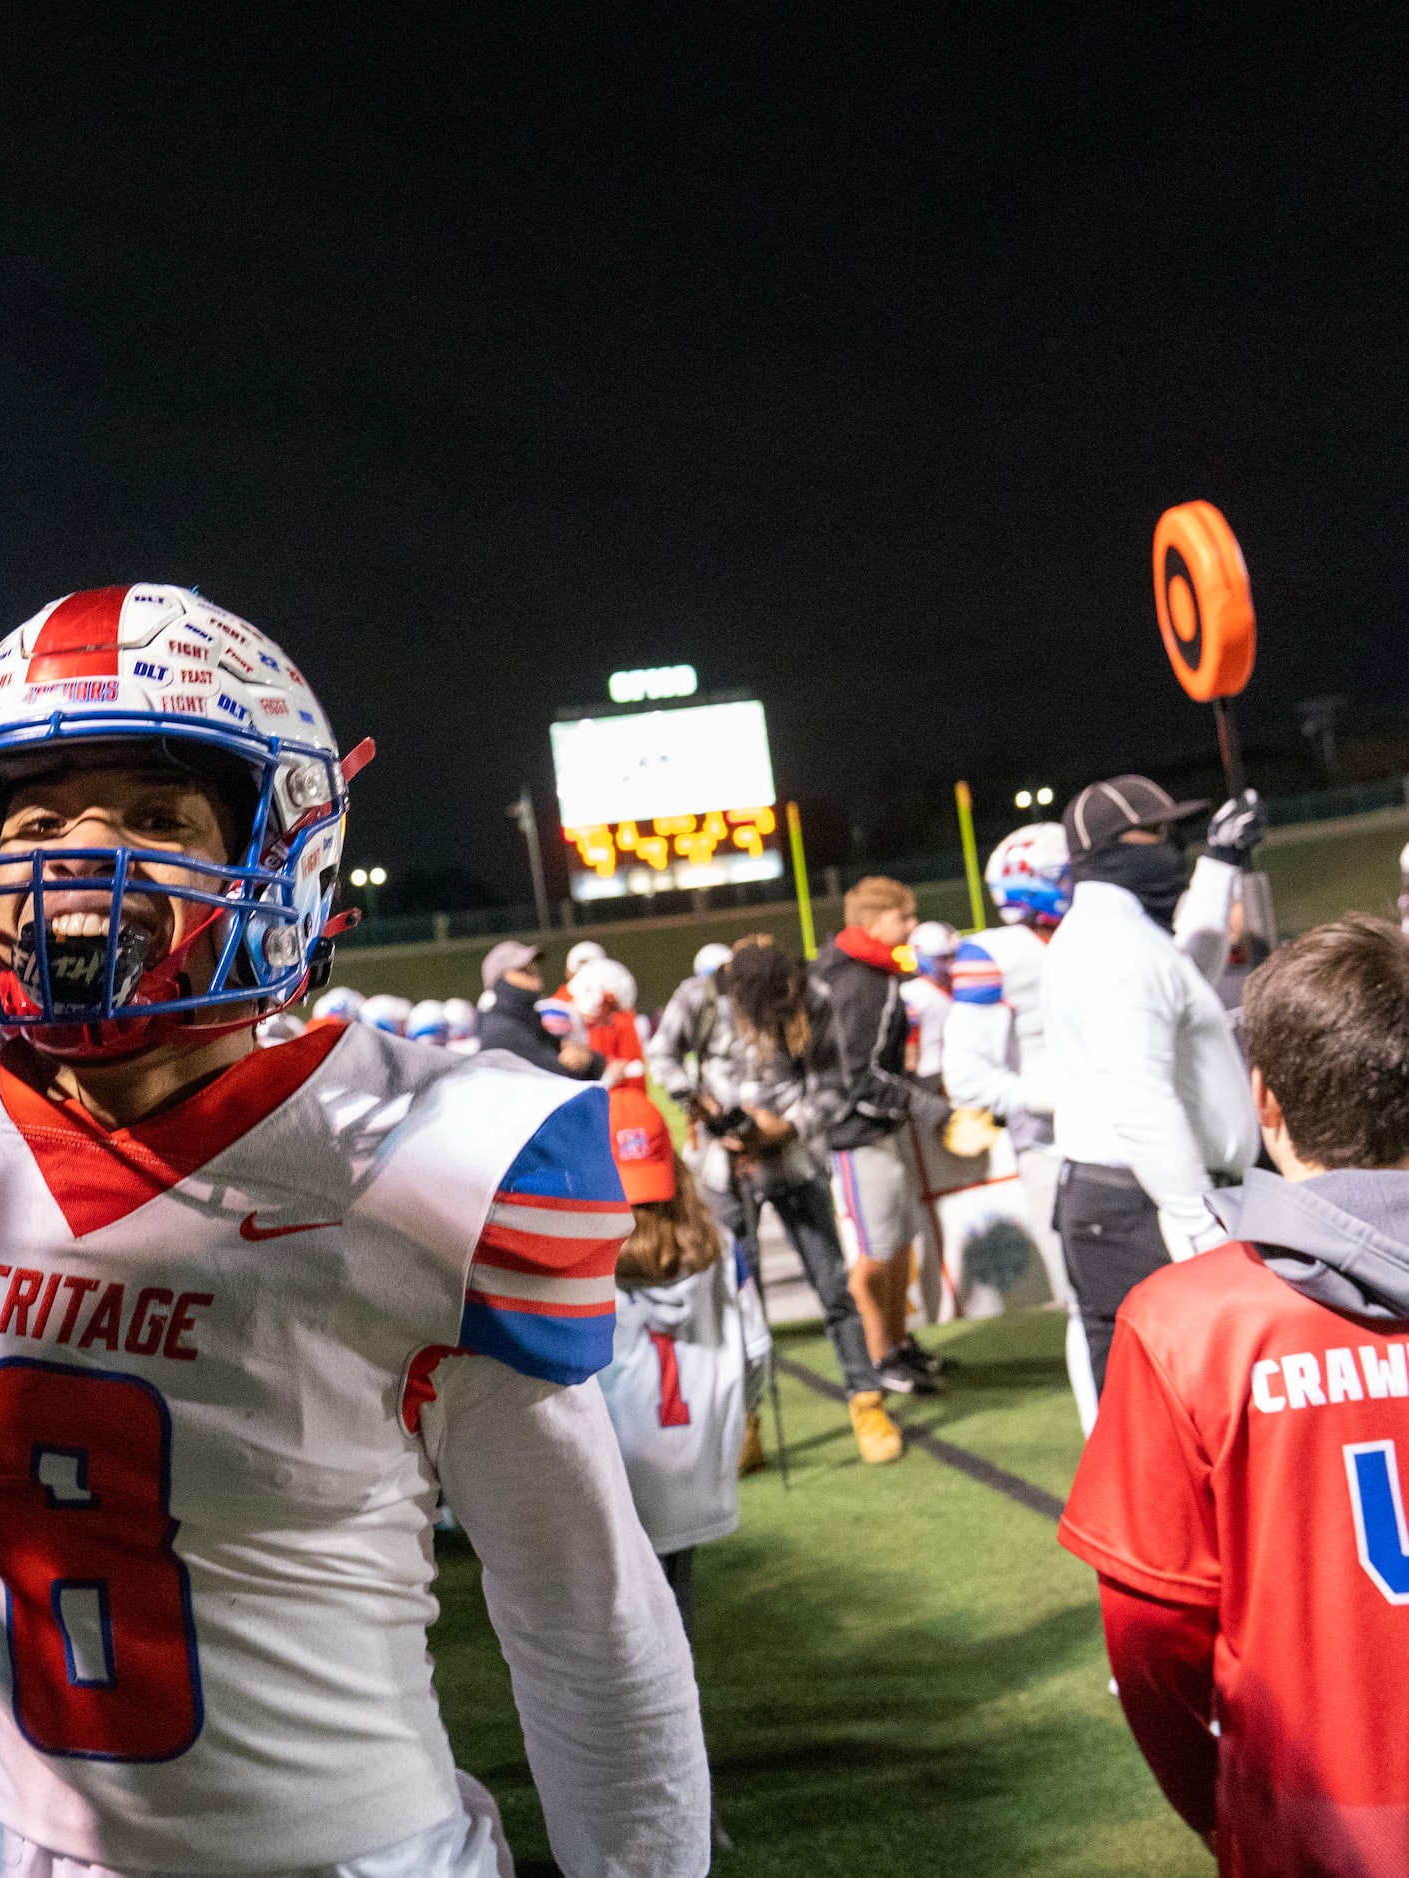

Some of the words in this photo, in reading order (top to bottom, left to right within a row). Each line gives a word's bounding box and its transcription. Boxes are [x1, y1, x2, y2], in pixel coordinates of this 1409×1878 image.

[209, 617, 247, 645] FIGHT
[168, 639, 209, 661] FIGHT
[132, 660, 168, 681] DLT
[180, 669, 213, 684] FEAST
[161, 694, 205, 714] FIGHT
[217, 693, 249, 721] DLT
[1250, 1343, 1409, 1415] CRAW
